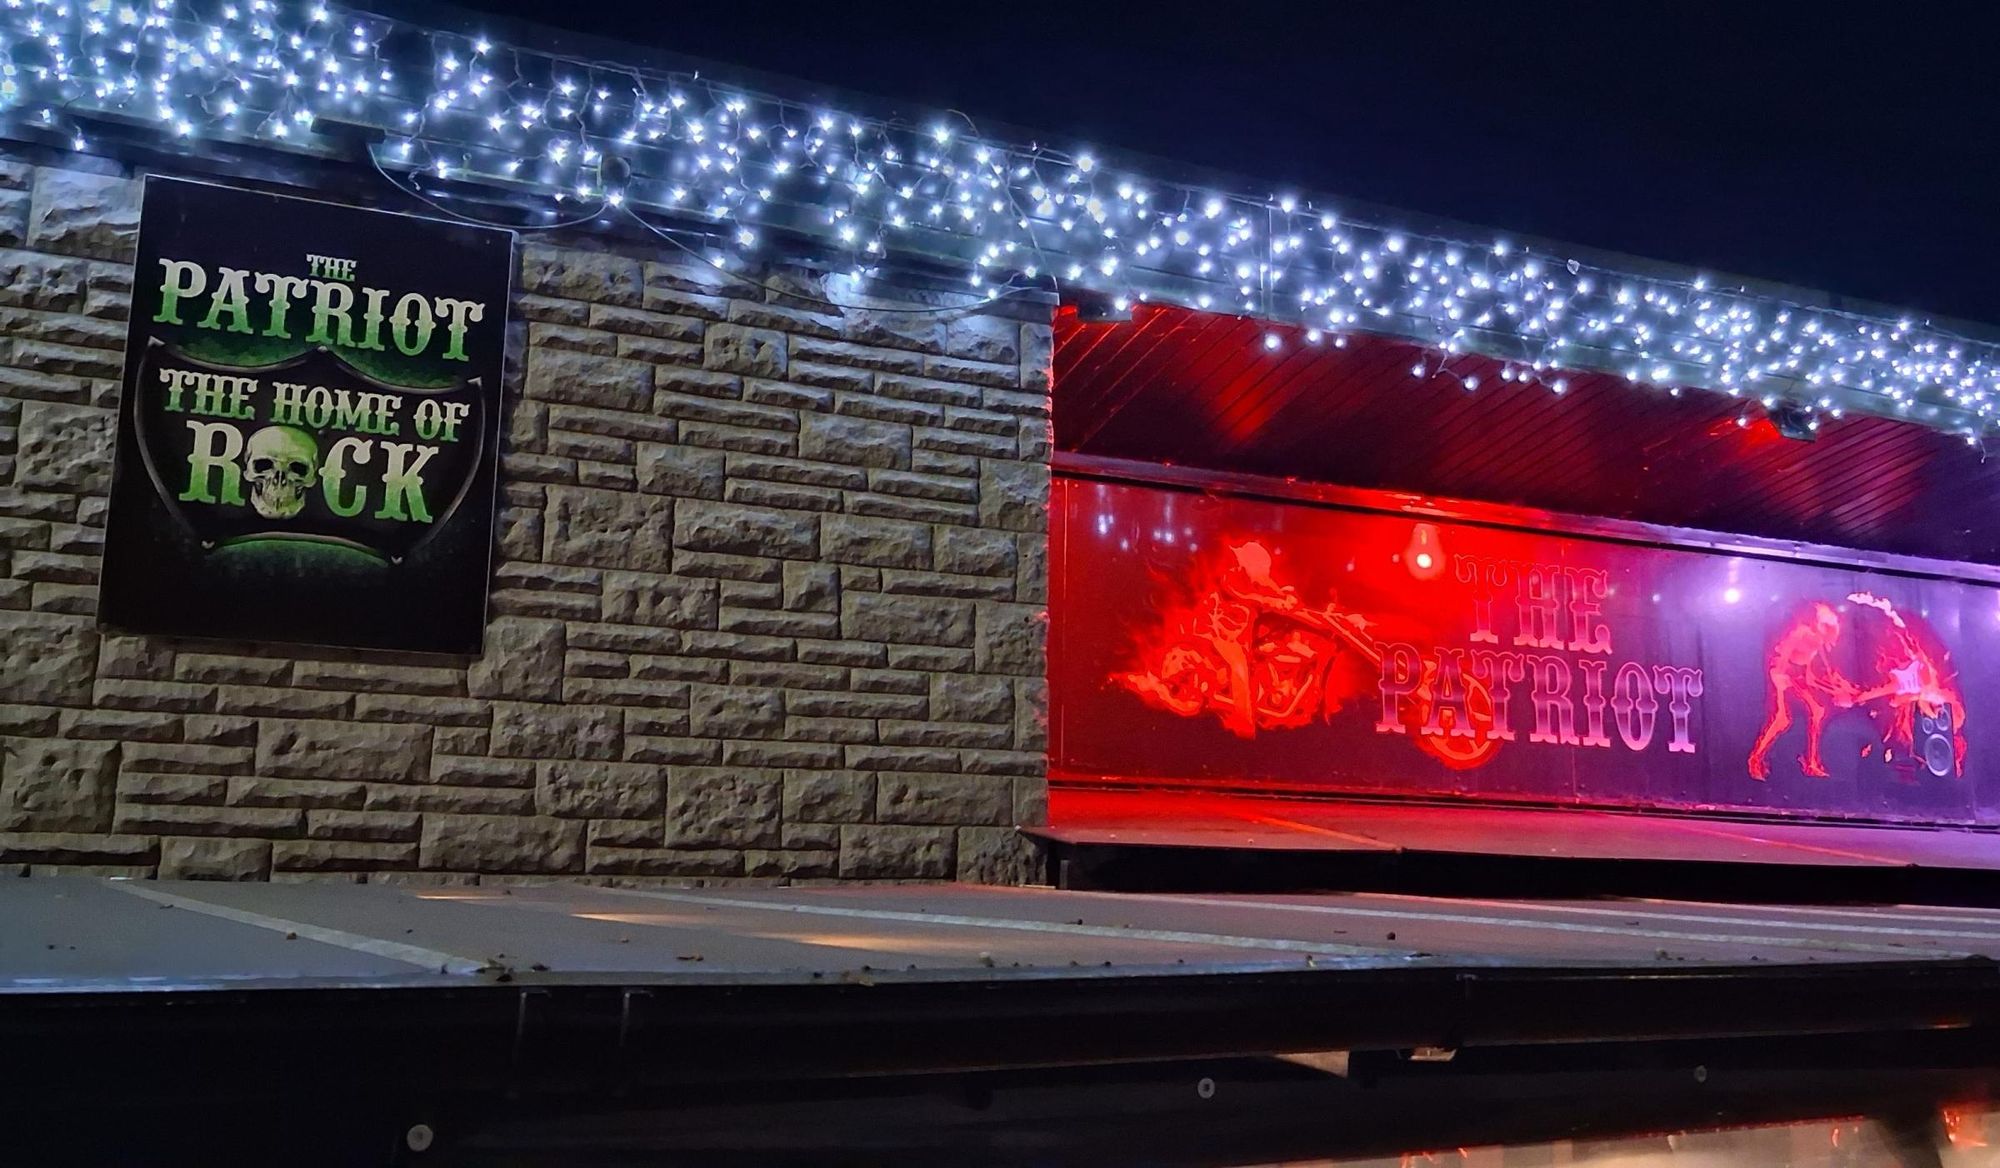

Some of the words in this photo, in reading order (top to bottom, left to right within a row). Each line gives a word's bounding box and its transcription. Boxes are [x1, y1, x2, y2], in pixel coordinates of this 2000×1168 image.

[153, 258, 486, 361] PATRIOT
[306, 254, 356, 281] THE
[160, 368, 258, 419] THE
[272, 382, 403, 436] HOME
[414, 399, 470, 442] OF
[1455, 555, 1613, 655] THE
[1376, 643, 1703, 753] PATRIOT
